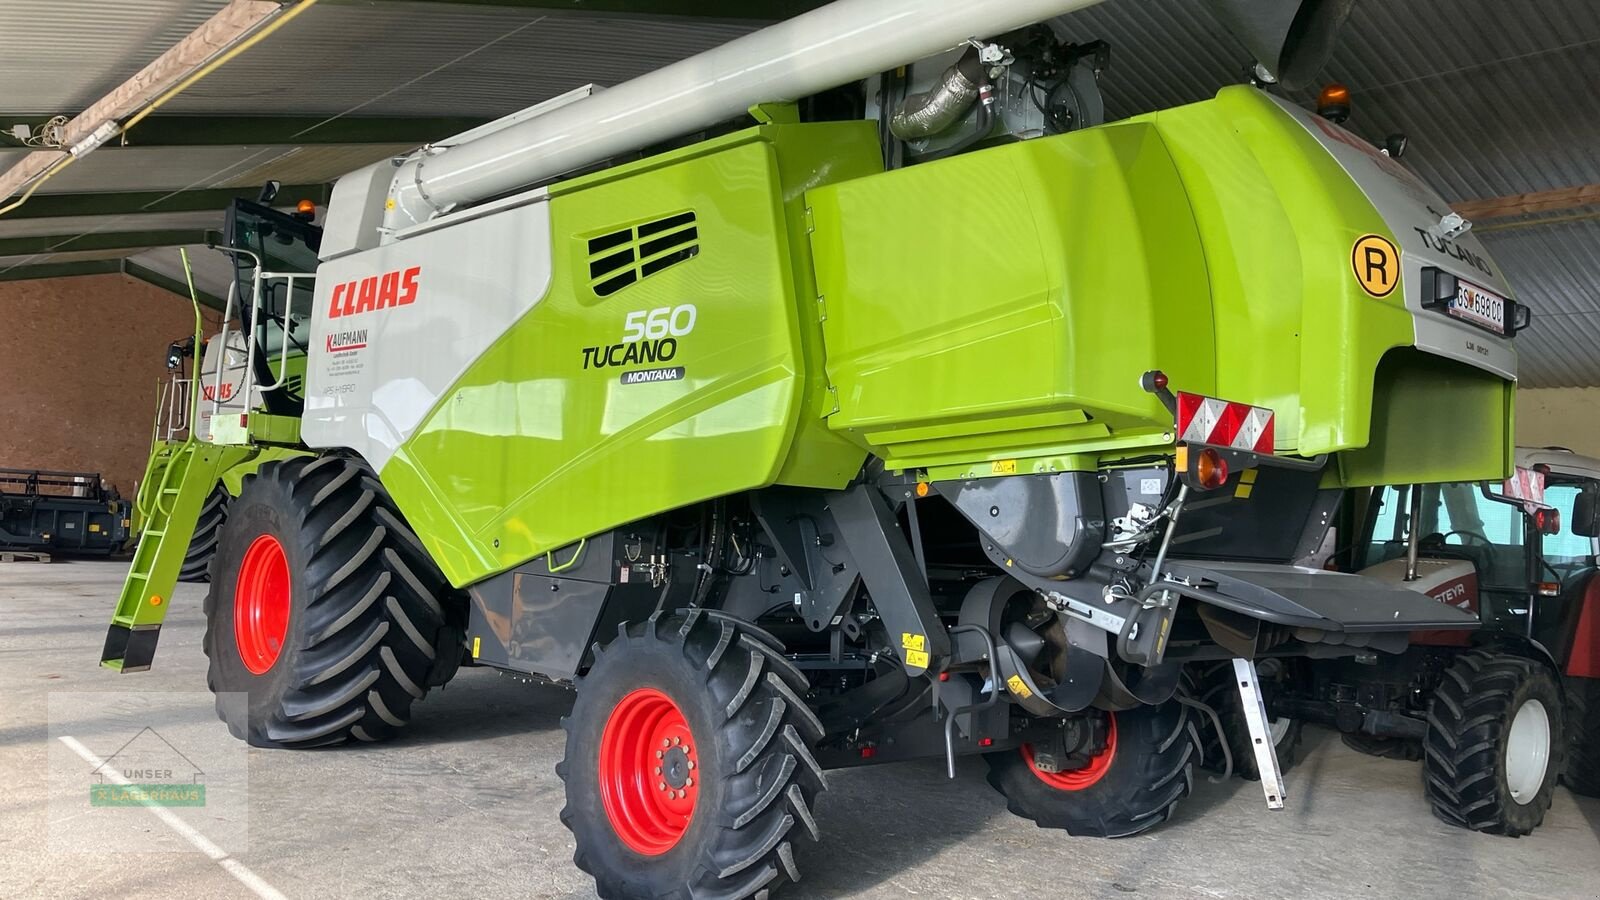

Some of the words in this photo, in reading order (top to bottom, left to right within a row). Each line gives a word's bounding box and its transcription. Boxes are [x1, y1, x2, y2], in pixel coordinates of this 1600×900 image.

[1364, 246, 1388, 286] R
[1414, 226, 1493, 277] TUCANO
[329, 266, 421, 319] CLAAS
[1457, 286, 1469, 310] GS
[326, 329, 368, 353] KAUFMANN
[622, 304, 697, 343] 560
[582, 338, 677, 370] TUCANO
[627, 369, 677, 383] MONTANA
